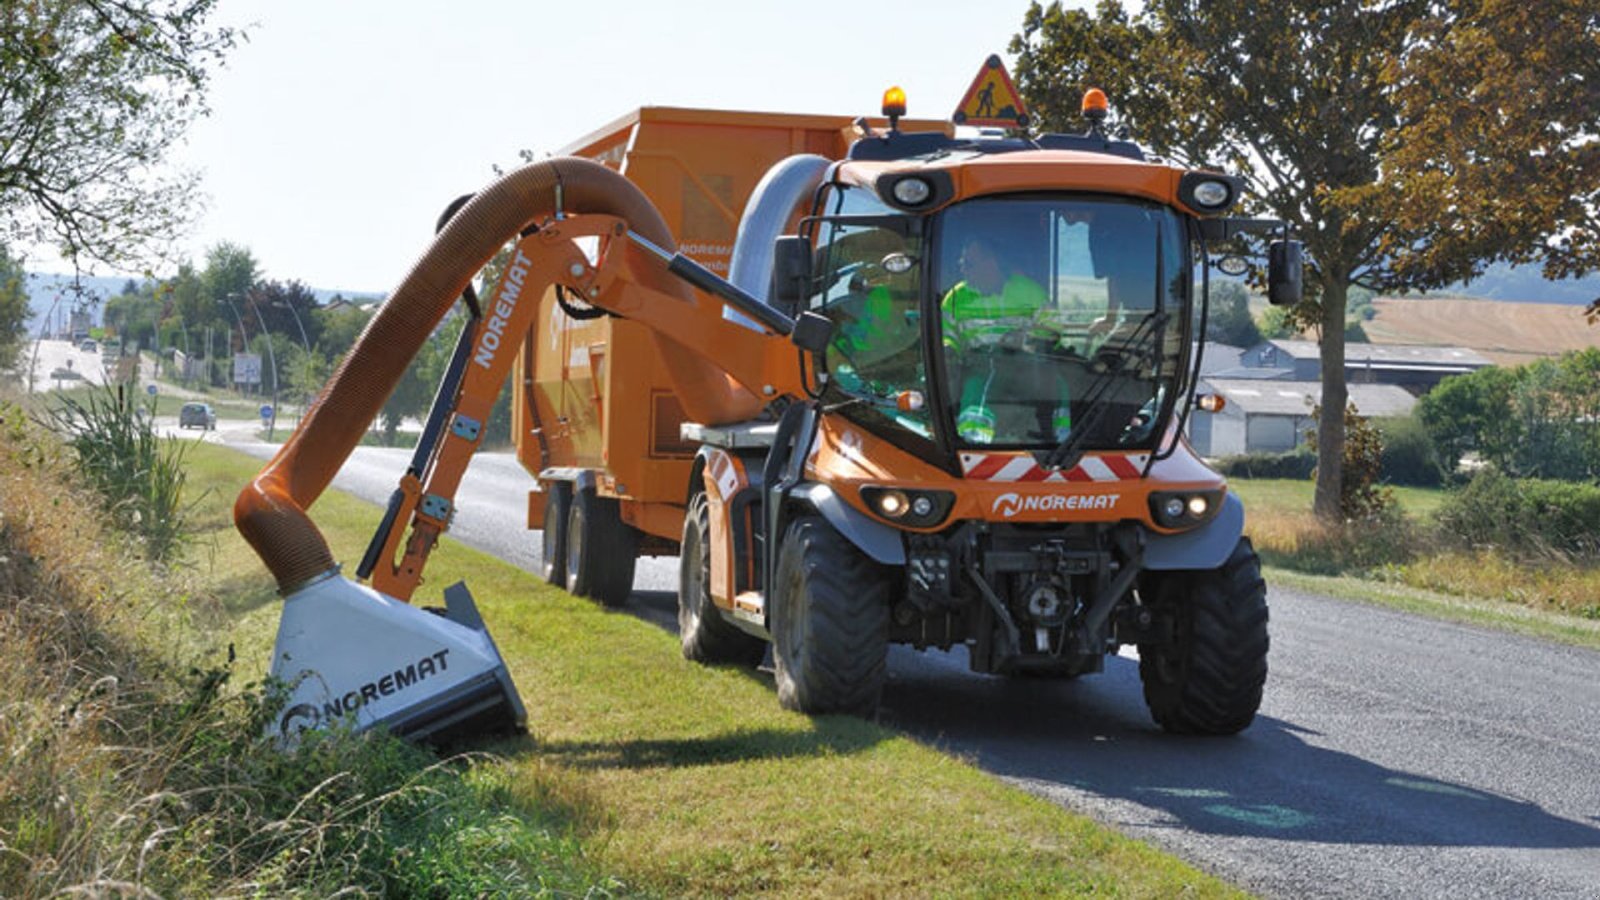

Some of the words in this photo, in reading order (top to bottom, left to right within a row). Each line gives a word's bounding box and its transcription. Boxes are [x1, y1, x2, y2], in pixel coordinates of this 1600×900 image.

[474, 249, 532, 369] NOREMAT
[1024, 494, 1121, 511] NOREMAT
[323, 649, 449, 721] NOREMAT
